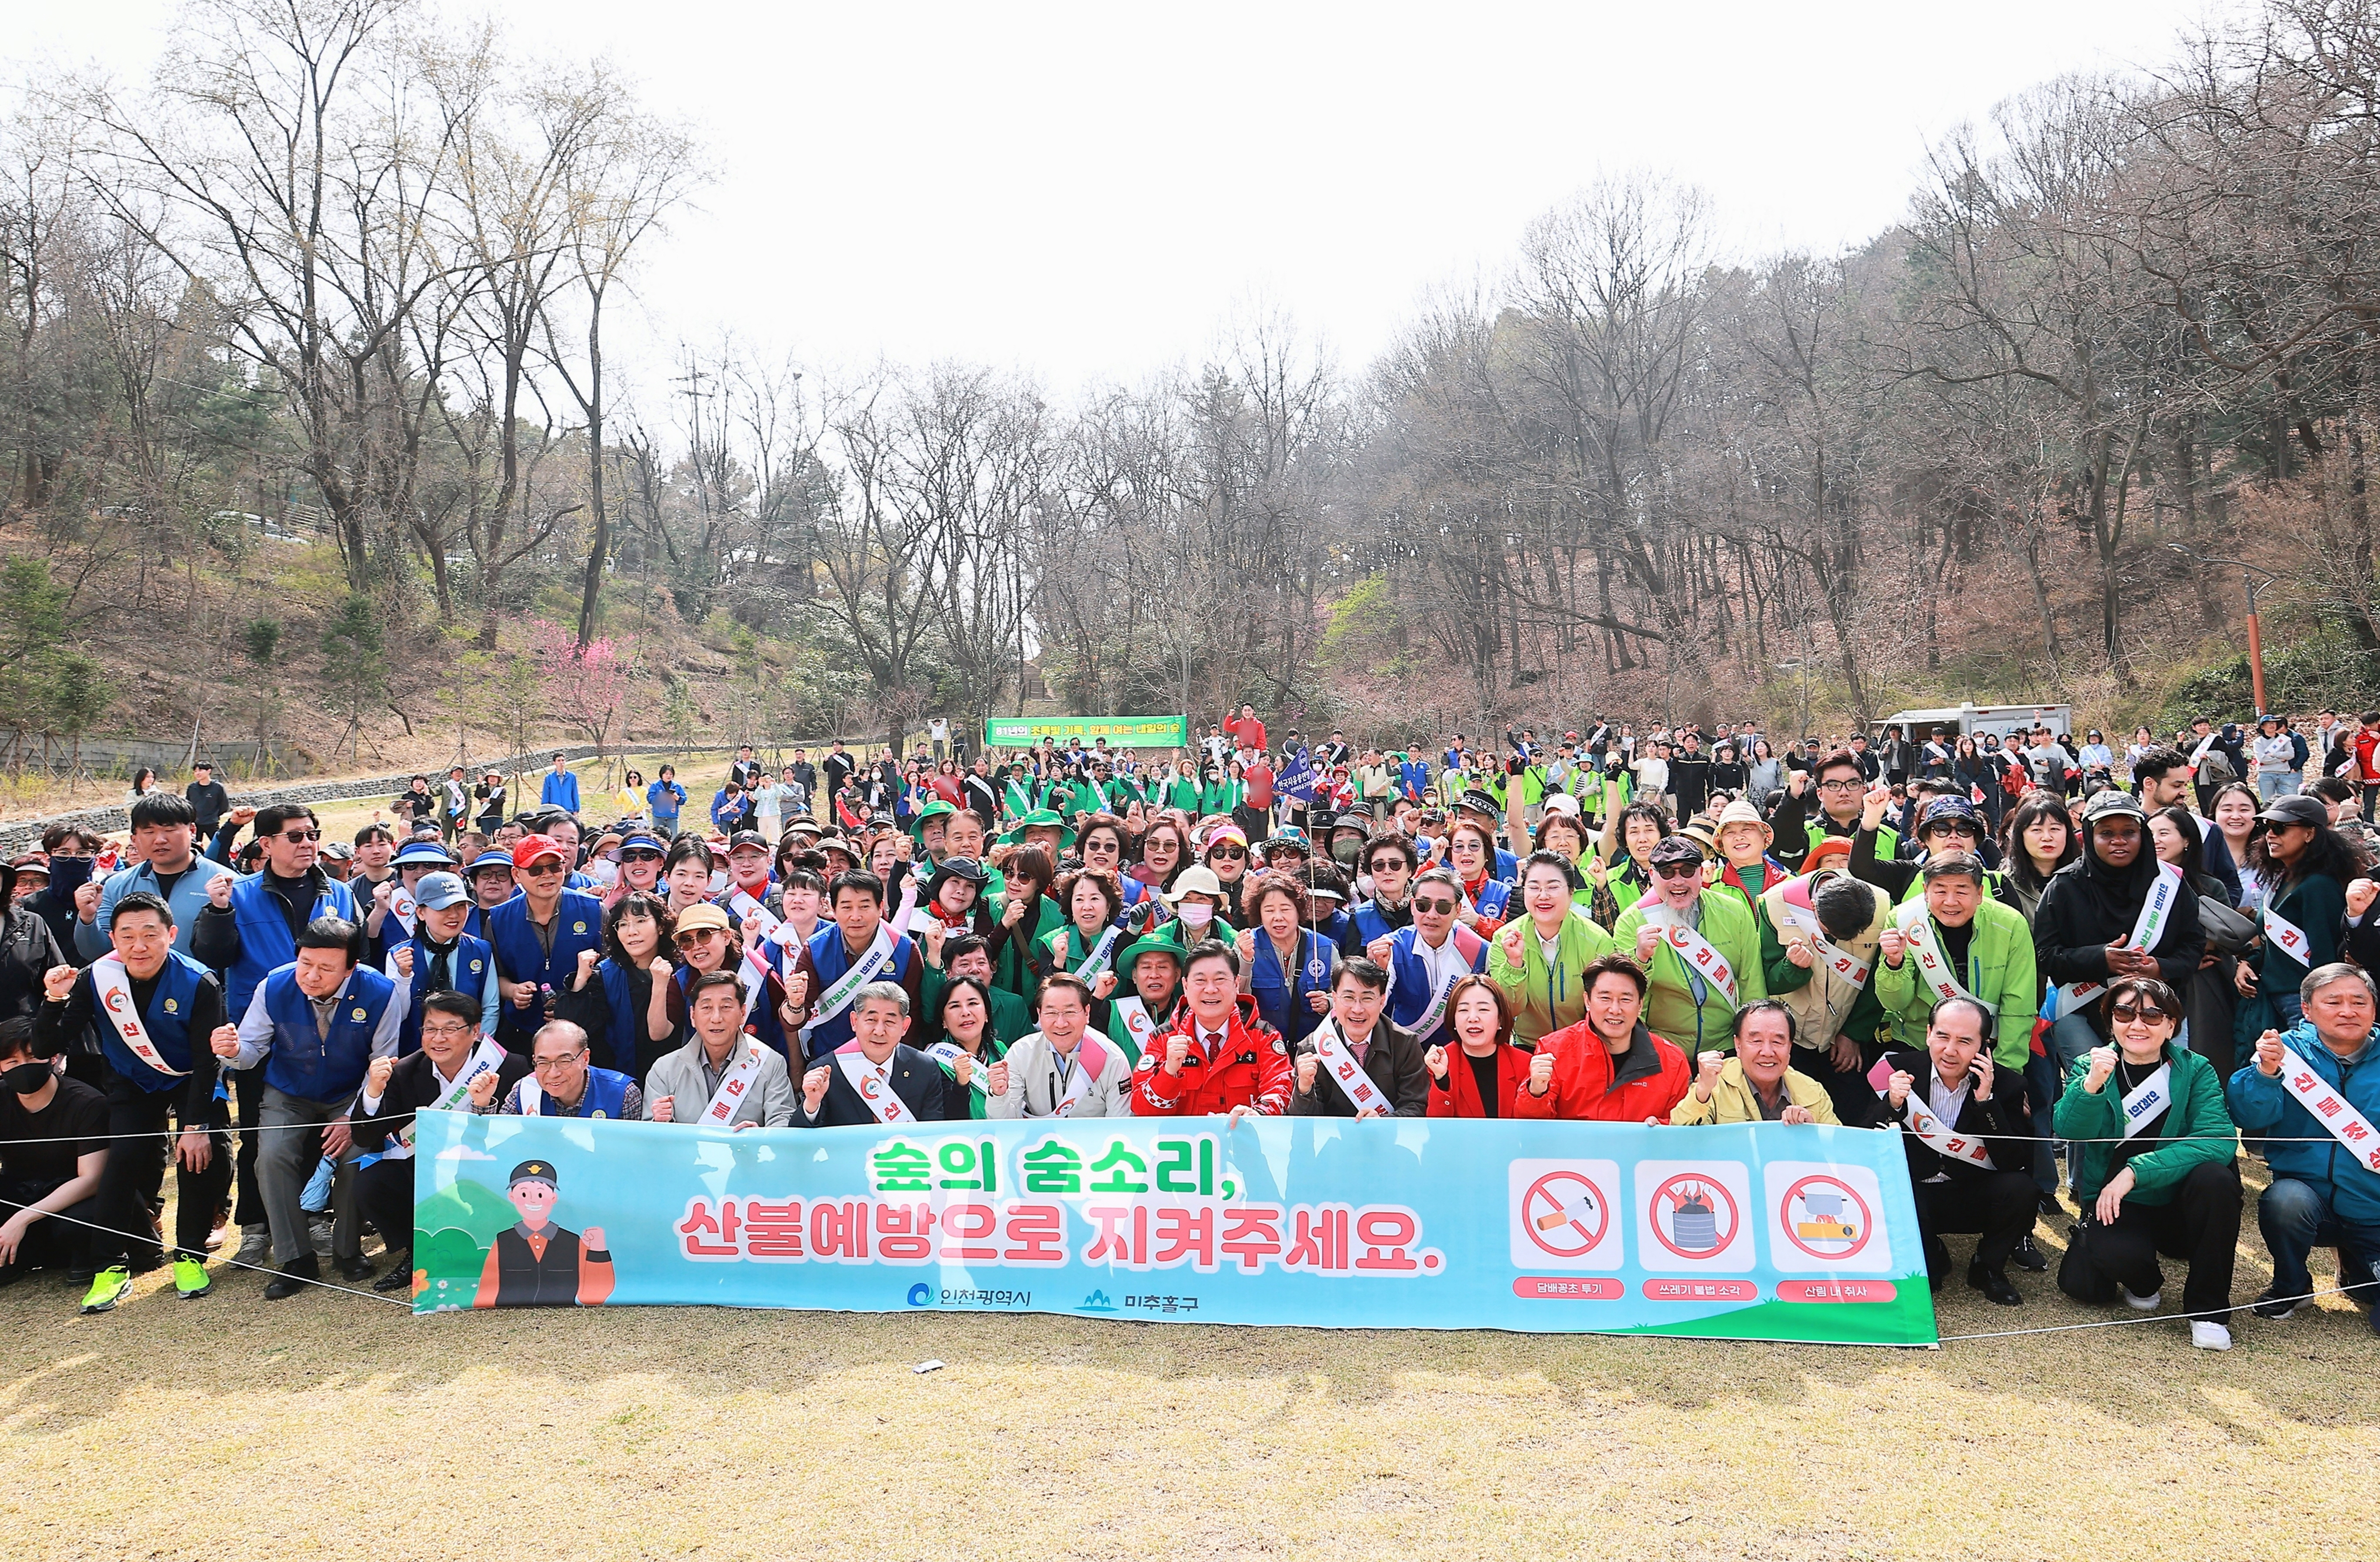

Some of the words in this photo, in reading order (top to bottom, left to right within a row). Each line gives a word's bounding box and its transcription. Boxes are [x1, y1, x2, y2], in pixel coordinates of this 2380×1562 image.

[996, 726, 1028, 736] 81년의
[1030, 725, 1061, 736] 초록빛
[1063, 725, 1086, 736] 기록,
[1089, 725, 1110, 735] 함께
[1113, 725, 1133, 734] 여는
[1136, 723, 1167, 734] 내일의
[2153, 883, 2169, 911] 인천의
[859, 951, 882, 975] 인천의
[2127, 1090, 2161, 1119] 인천의
[873, 1141, 996, 1192] 숲의
[1024, 1139, 1236, 1201] 숨소리,
[679, 1201, 1063, 1261] 산불예방으로
[1087, 1205, 1439, 1270] 지켜주세요.
[1537, 1282, 1579, 1295] 담배꽁초
[1581, 1283, 1603, 1295] 투기
[1658, 1283, 1692, 1296] 쓰레기
[1694, 1284, 1716, 1297] 불법
[1718, 1284, 1741, 1297] 소각
[1804, 1285, 1828, 1298] 산림
[1830, 1285, 1841, 1298] 내
[1844, 1286, 1868, 1298] 취사
[940, 1289, 1031, 1307] 인천광역시
[1125, 1295, 1199, 1313] 미추홀구
